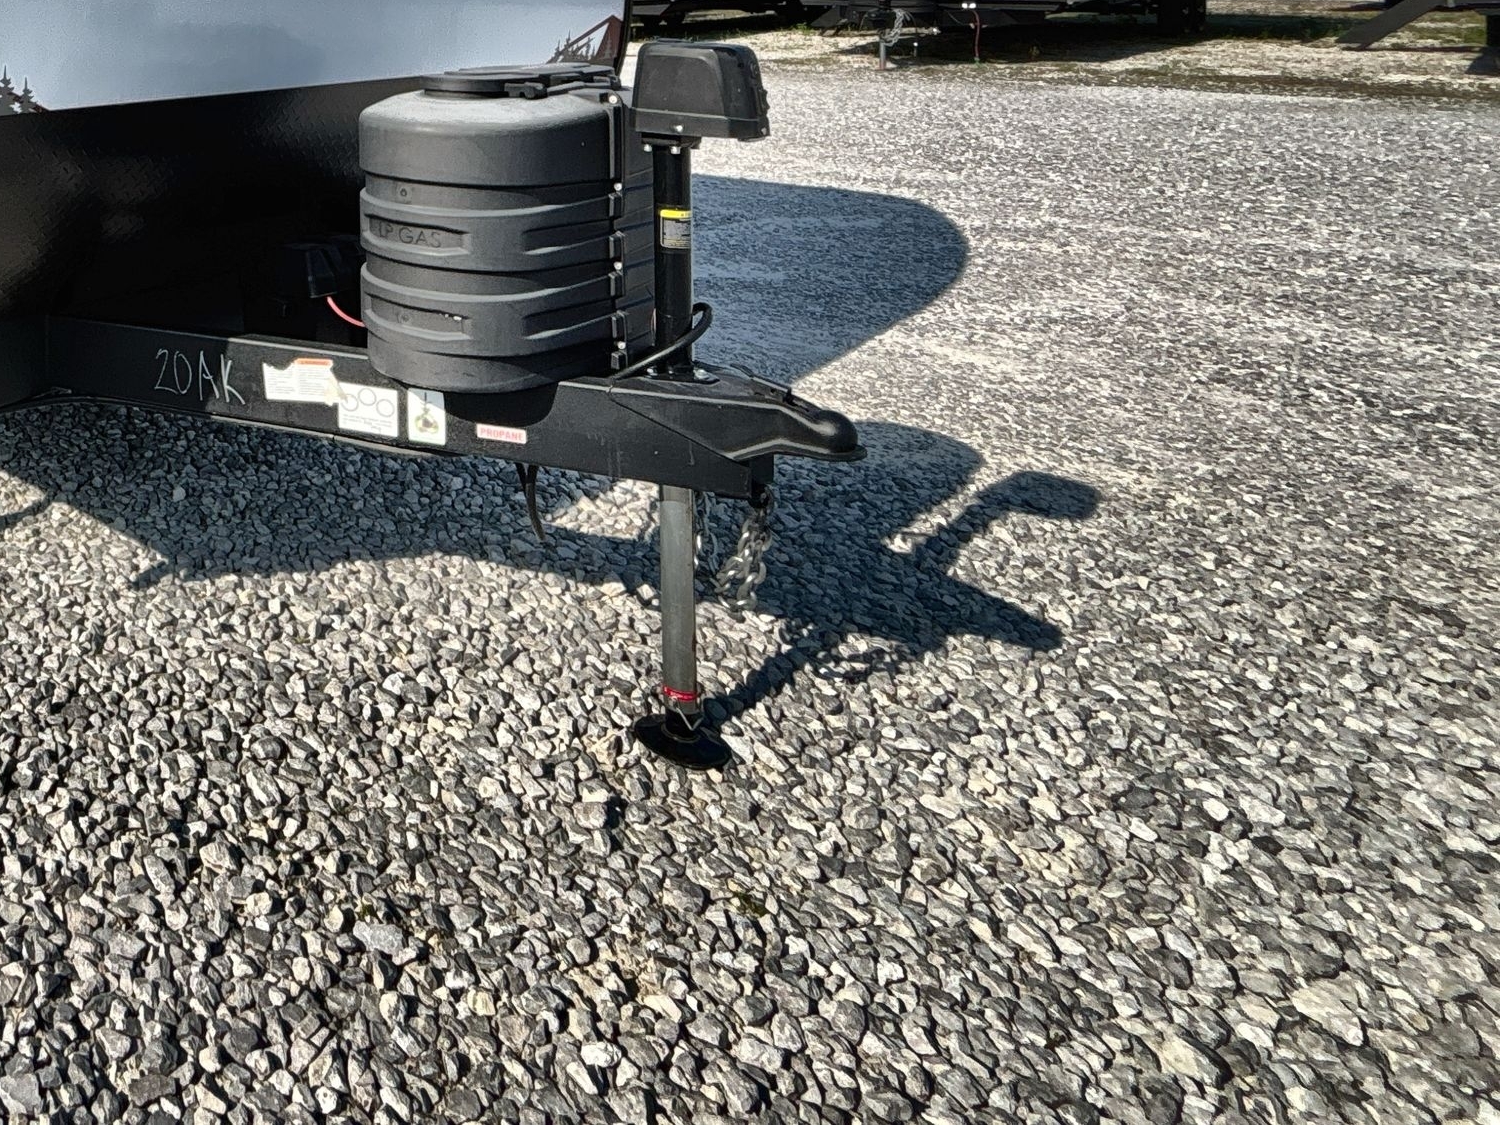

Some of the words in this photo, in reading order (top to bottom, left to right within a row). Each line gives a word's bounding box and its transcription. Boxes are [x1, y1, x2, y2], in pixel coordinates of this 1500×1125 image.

[398, 227, 442, 248] GAS
[154, 348, 246, 405] 20AK
[480, 426, 526, 442] PROPANE
